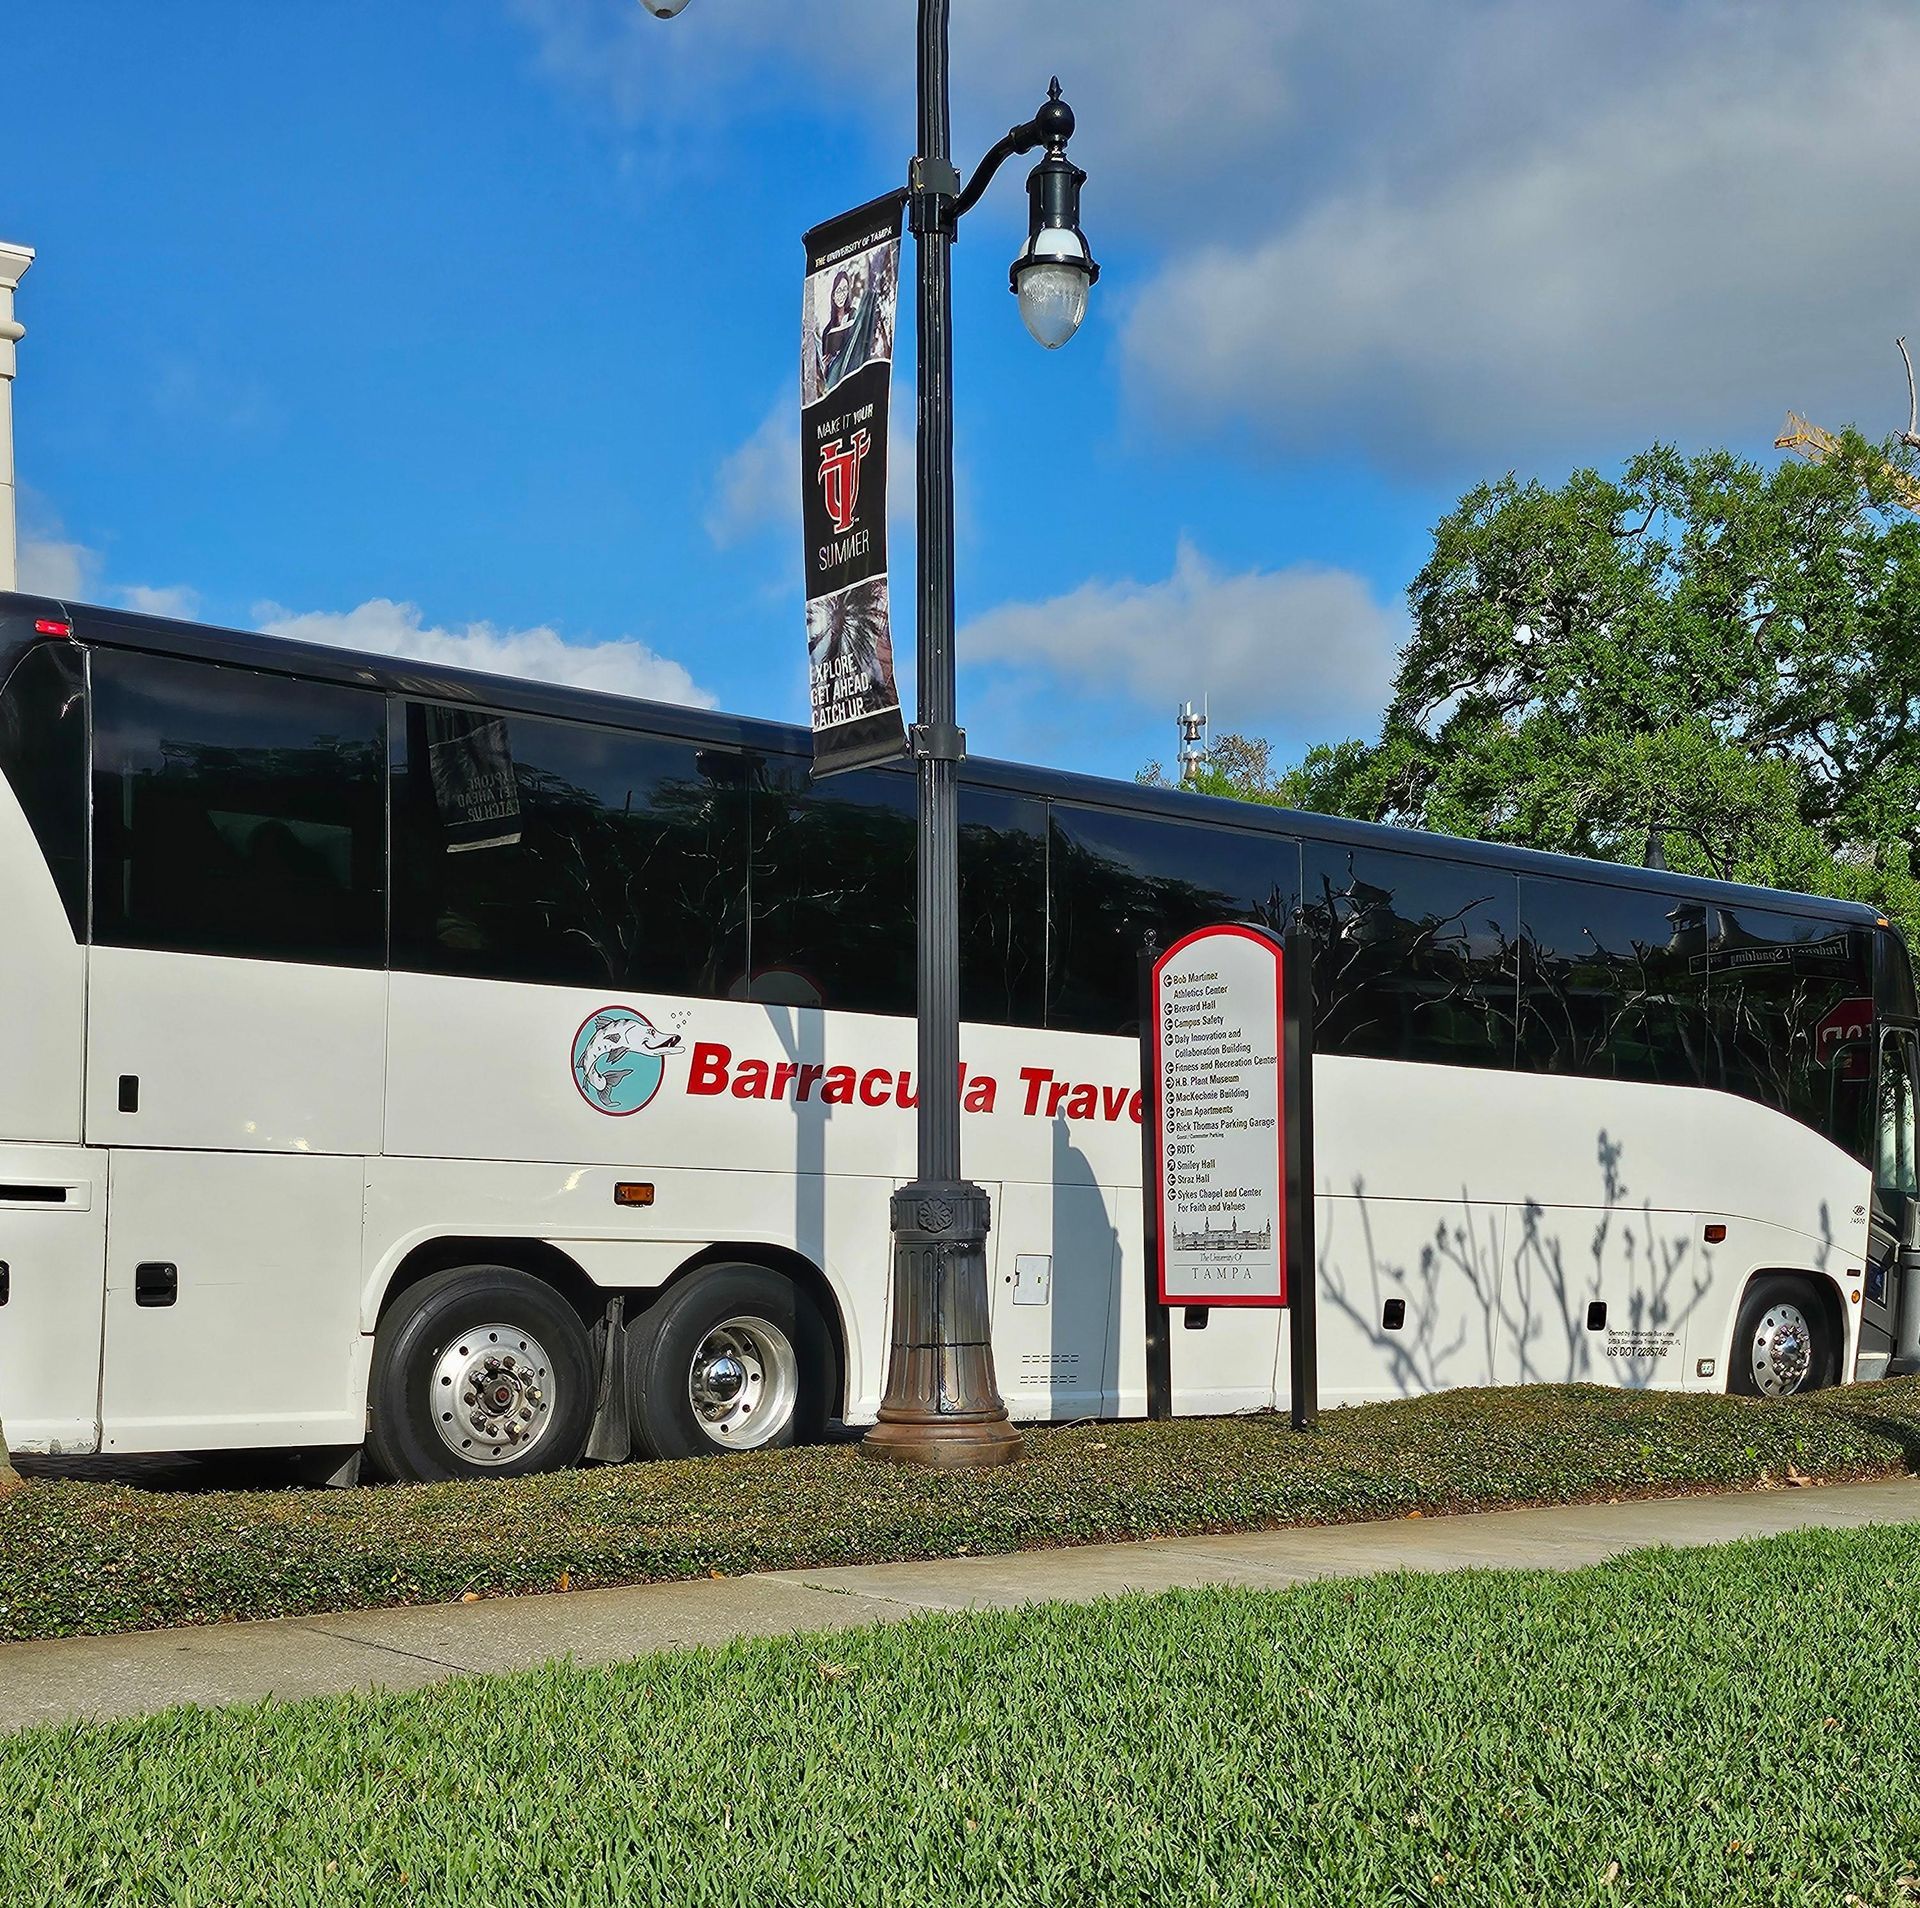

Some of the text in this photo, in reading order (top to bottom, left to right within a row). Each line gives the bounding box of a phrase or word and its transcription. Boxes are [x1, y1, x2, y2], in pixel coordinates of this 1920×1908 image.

[815, 226, 893, 268] THE UNIVERSITY OF TAMPA
[817, 403, 874, 439] MAKE IT YOUR
[818, 529, 870, 571] SUMMER
[810, 684, 831, 707] GET
[812, 701, 847, 730] CATCH
[1173, 971, 1219, 985] Bob Martinez
[1173, 985, 1229, 1000] Athletics Center
[1174, 1000, 1216, 1014] Brevard Hall
[1174, 1015, 1224, 1029] Campus Safety
[1174, 1028, 1241, 1045] Daly Innovation and
[1175, 1043, 1252, 1059] Collaboration Building
[1175, 1055, 1278, 1073] Fitness and Recreation Center
[686, 1041, 1144, 1124] Barracua Trave
[1175, 1074, 1240, 1087] H.B. Plant Museum
[1175, 1087, 1249, 1103] MacKechnie Building
[1175, 1105, 1234, 1118] Palm Apartments
[1176, 1117, 1275, 1132] Rick Thomas Parking Garage
[1176, 1144, 1196, 1155] ROTC
[1177, 1159, 1216, 1171] Smiley Hall
[1177, 1174, 1210, 1185] Straz Hall
[1177, 1187, 1262, 1201] Sykes Chapel and Center
[1177, 1201, 1246, 1213] For Faith and Values
[1191, 1266, 1253, 1280] TAMPA
[1607, 1346, 1618, 1357] US
[1619, 1346, 1636, 1357] DOT
